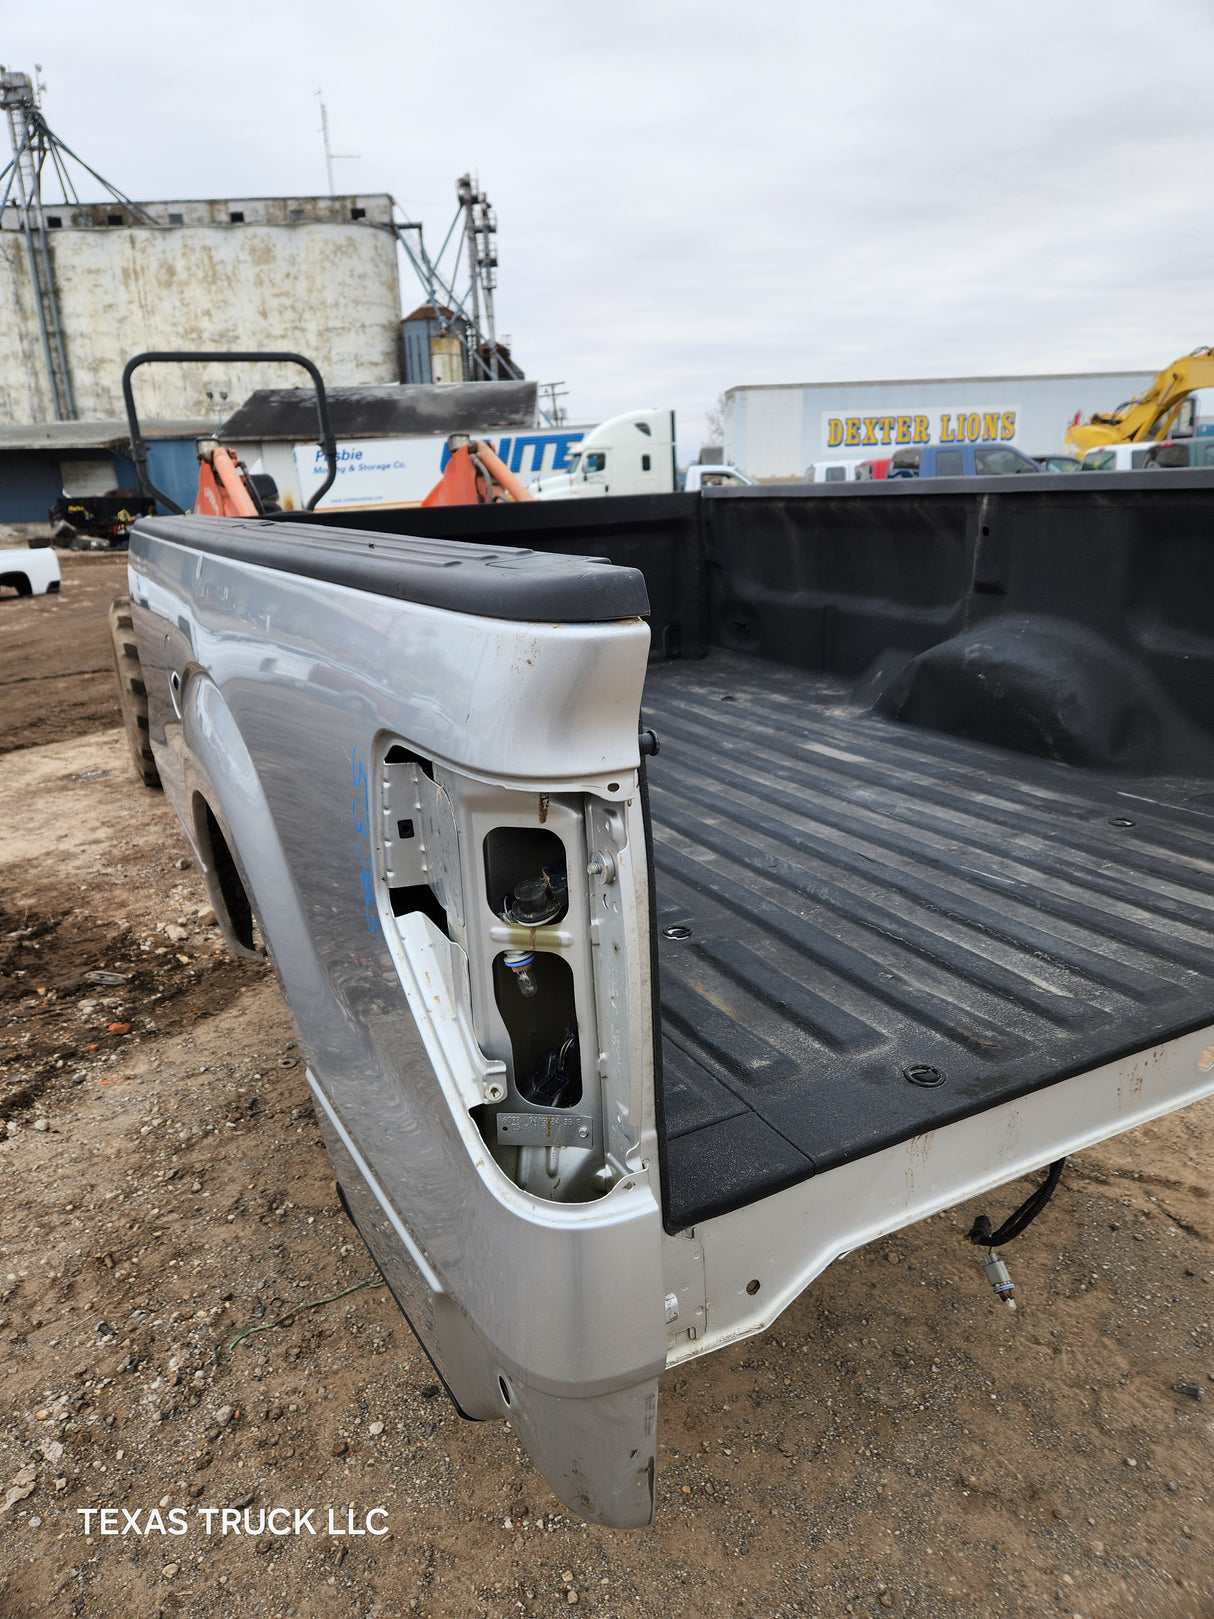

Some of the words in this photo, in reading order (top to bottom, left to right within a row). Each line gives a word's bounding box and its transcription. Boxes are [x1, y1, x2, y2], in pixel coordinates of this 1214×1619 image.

[827, 416, 930, 448] DEXTER
[939, 411, 1016, 443] LIONS
[313, 465, 346, 475] Mong
[358, 462, 391, 472] Storage
